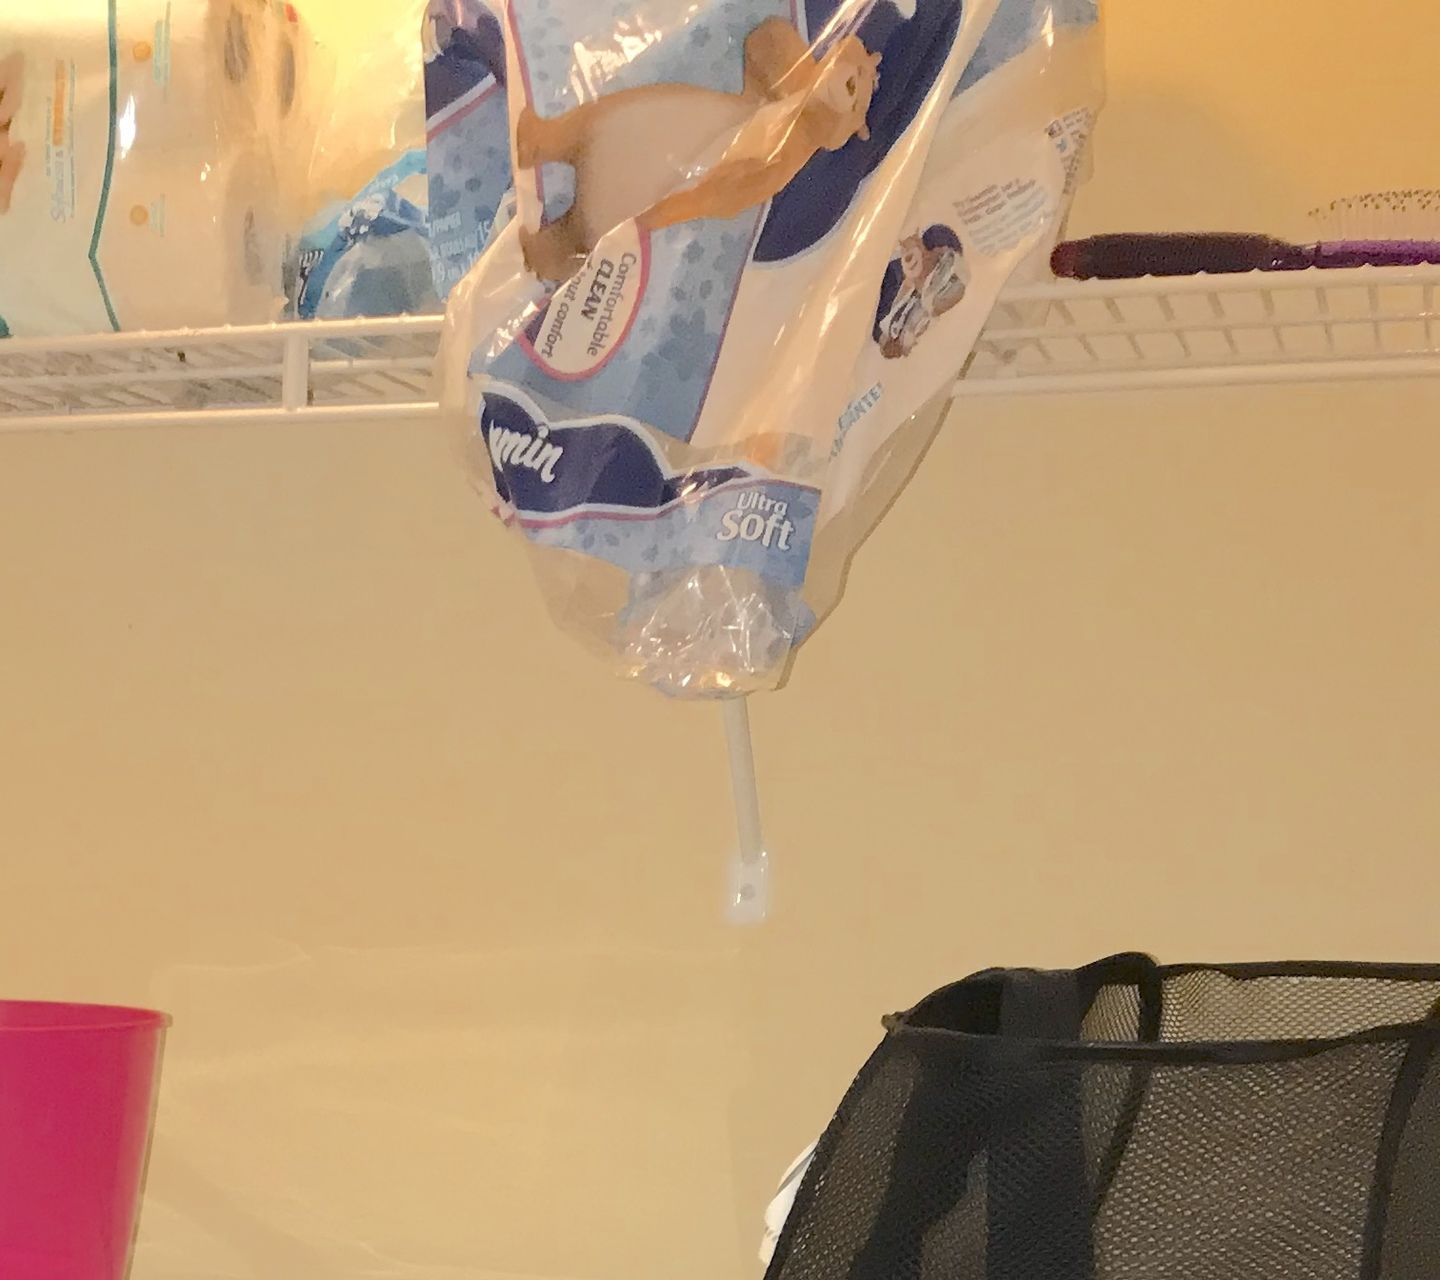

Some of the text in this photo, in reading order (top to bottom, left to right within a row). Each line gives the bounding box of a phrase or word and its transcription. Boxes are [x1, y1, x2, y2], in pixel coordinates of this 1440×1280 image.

[581, 259, 613, 320] CLEAN
[587, 253, 636, 356] Comfortable
[737, 492, 785, 516] Ultra
[716, 509, 794, 551] Soft
